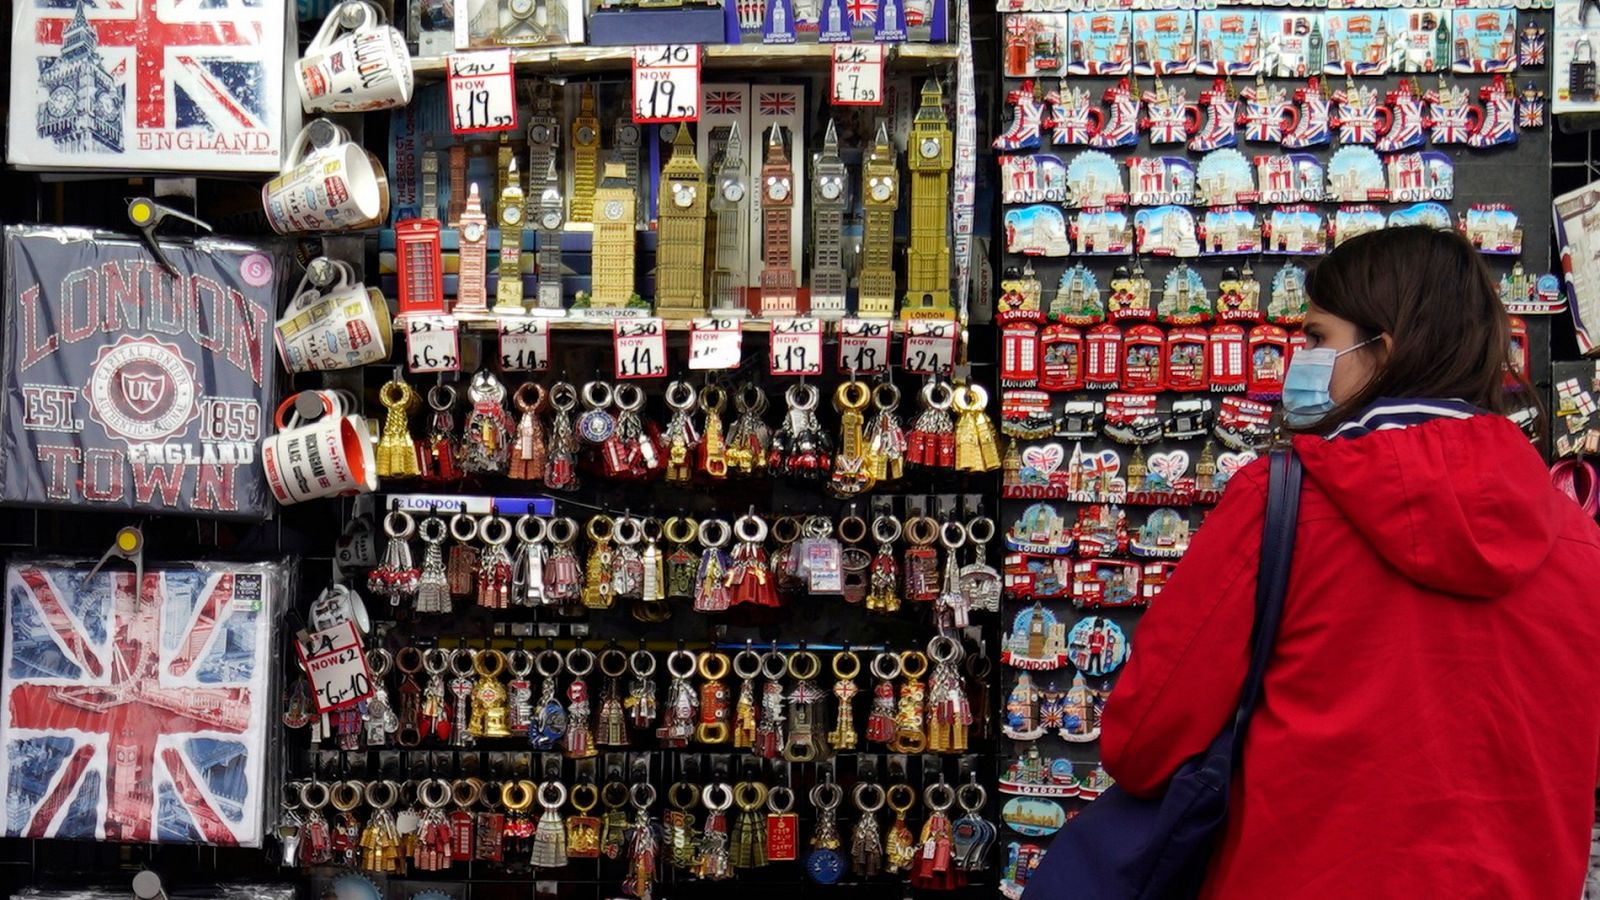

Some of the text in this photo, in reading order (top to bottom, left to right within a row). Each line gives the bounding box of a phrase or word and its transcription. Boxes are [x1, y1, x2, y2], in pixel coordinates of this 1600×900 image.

[640, 71, 671, 80] NOW
[455, 80, 485, 90] NOW
[136, 131, 270, 150] ENGLAND
[1130, 191, 1193, 205] LONDON
[252, 261, 262, 275] S
[1003, 310, 1041, 319] LONDON
[1113, 309, 1151, 319] LONDON
[1221, 310, 1260, 319] LONDON
[20, 259, 268, 388] LONDON
[620, 339, 644, 347] NOW
[844, 339, 869, 347] NOW
[909, 338, 934, 346] NOW
[98, 346, 188, 385] CAPITAL LONDON
[1001, 379, 1037, 388] LONDON
[1085, 382, 1119, 390] LONDON
[1210, 383, 1246, 393] LONDON
[128, 380, 157, 402] UK
[23, 387, 84, 430] EST.
[98, 397, 145, 435] AUTHENTIC
[200, 400, 261, 441] 1859
[127, 443, 255, 465] ENGLAND
[287, 438, 303, 464] PALACE
[304, 432, 326, 477] BUCKINGHAM
[37, 444, 239, 511] TOWN
[1003, 484, 1070, 499] LONDON
[1127, 491, 1192, 506] LONDON
[408, 498, 463, 510] LONDON
[1018, 544, 1057, 554] LONDON
[1144, 548, 1184, 557] LONDON
[311, 655, 338, 672] NOW
[1013, 656, 1057, 671] LONDON
[350, 672, 370, 699] 10
